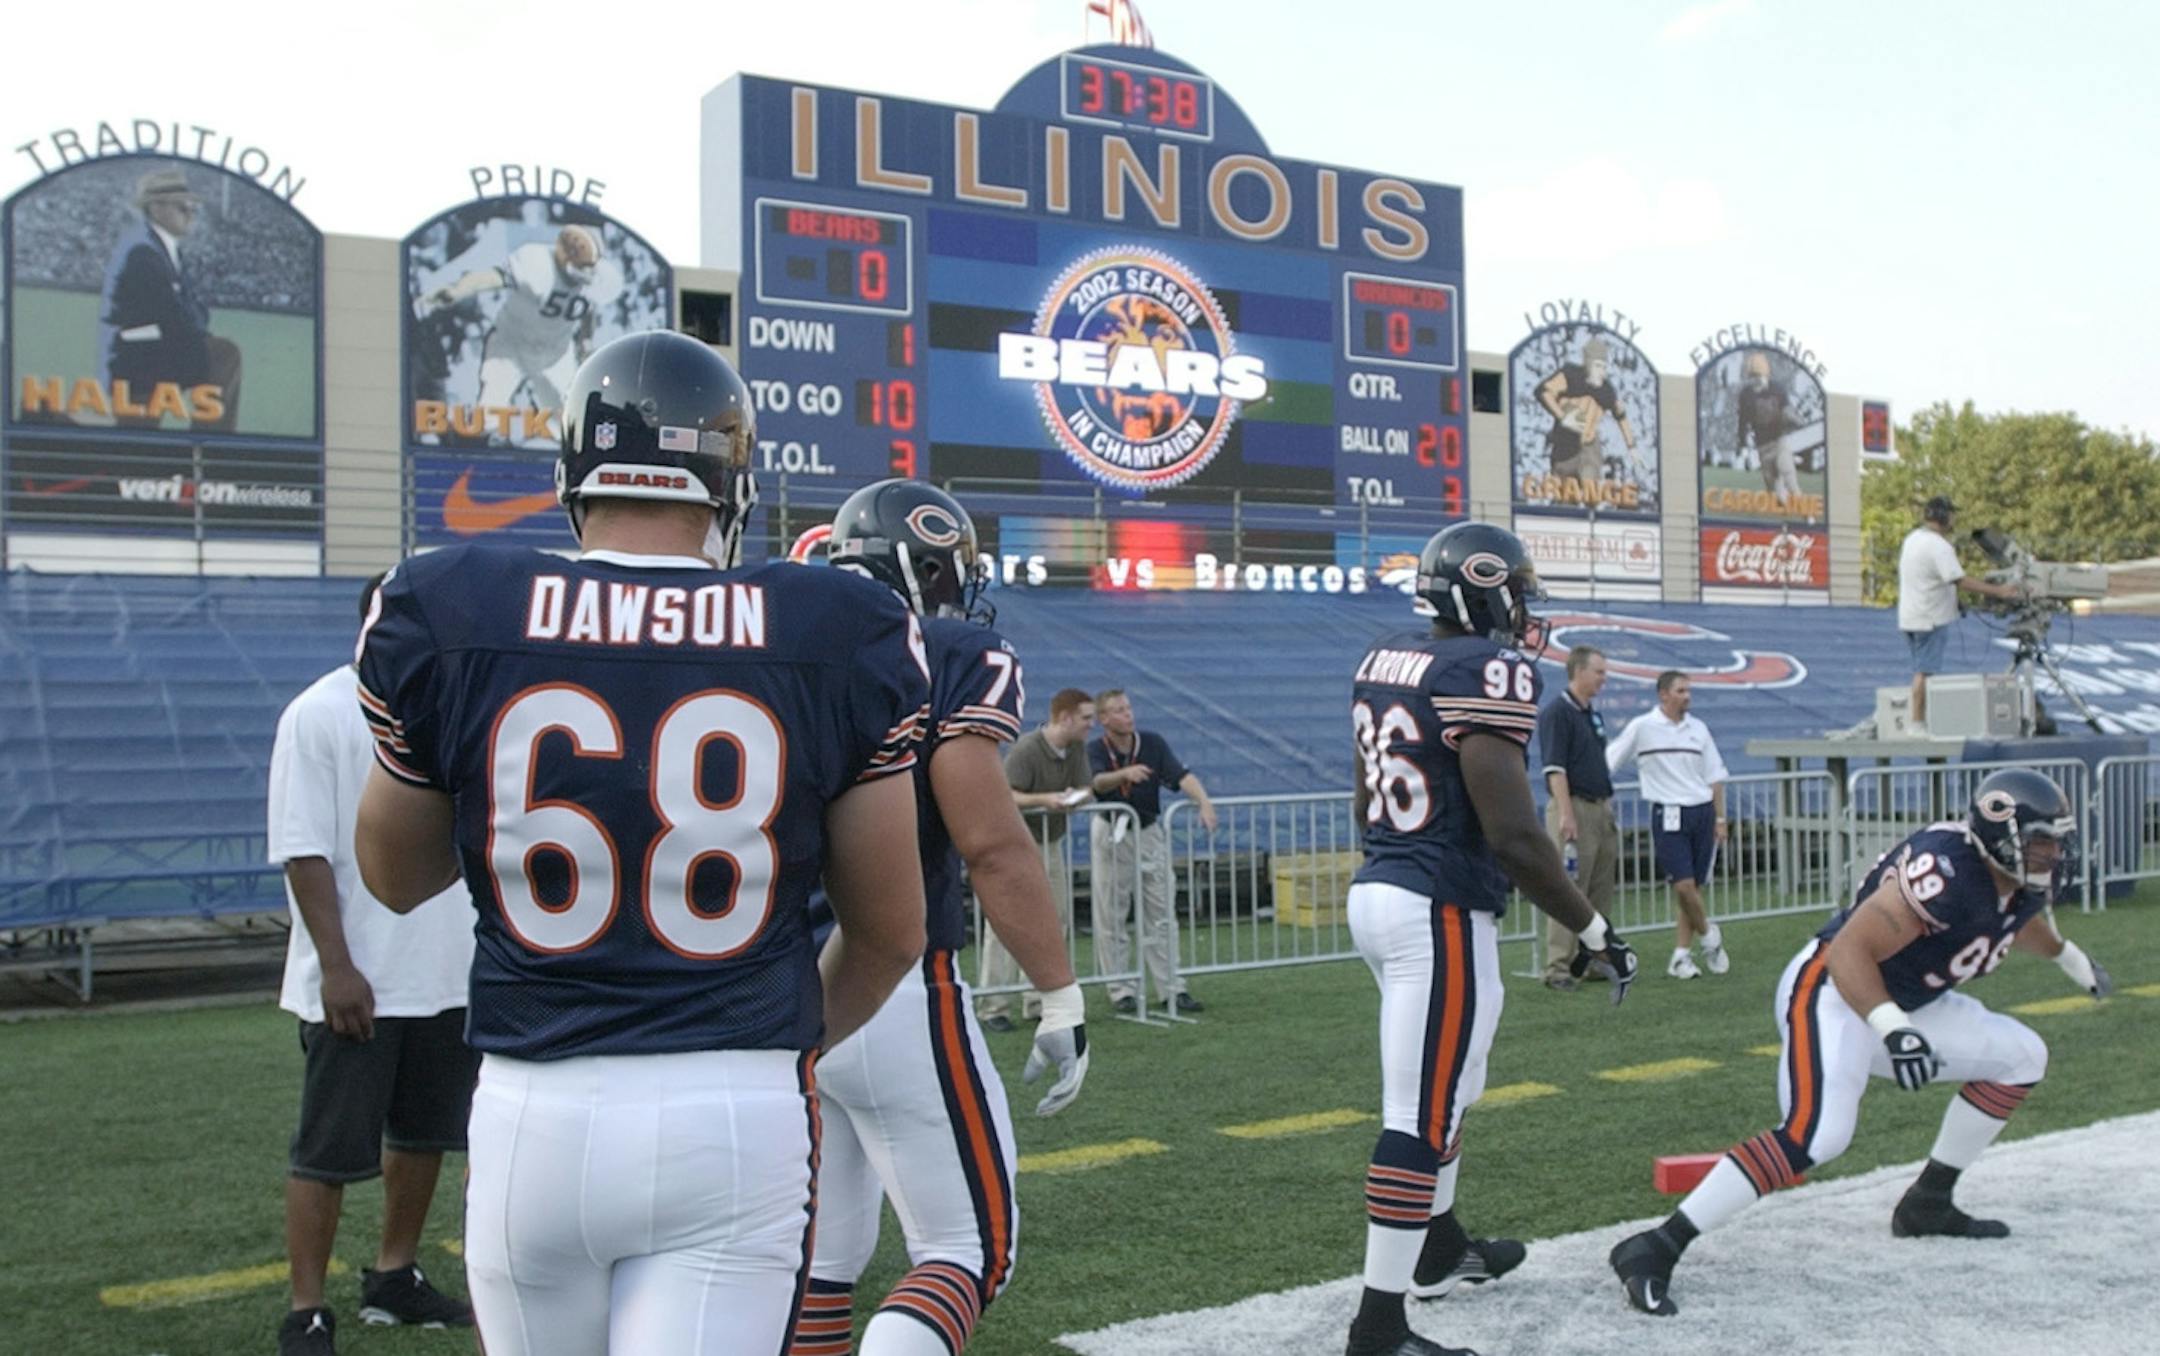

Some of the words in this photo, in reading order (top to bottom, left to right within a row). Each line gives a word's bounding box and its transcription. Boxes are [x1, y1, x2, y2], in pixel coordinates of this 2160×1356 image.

[1081, 64, 1198, 129] 37:38
[15, 118, 307, 202] TRADITION
[791, 86, 1430, 262] ILLINOIS
[469, 163, 607, 210] PRIDE
[787, 207, 881, 245] BEARS
[859, 250, 889, 302] 0
[1068, 269, 1122, 315] 2002
[1125, 268, 1202, 326] SEASON
[539, 291, 590, 322] 50
[1523, 297, 1642, 341] LOYALTY
[749, 316, 836, 354] DOWN
[902, 323, 916, 368] 1
[1386, 310, 1412, 356] 0
[1689, 322, 1829, 380] EXCELLENCE
[999, 332, 1269, 401] BEARS
[1348, 371, 1403, 402] QTR.
[21, 375, 226, 422] HALAS
[414, 399, 554, 439] BUTK
[750, 379, 791, 413] TO
[796, 382, 843, 417] GO
[871, 379, 917, 432] 10
[757, 439, 837, 475] T.O.L.
[1066, 408, 1094, 438] IN
[1090, 417, 1206, 469] CHAMPAIGN
[1340, 424, 1384, 455] BALL
[1384, 428, 1410, 455] ON
[1416, 422, 1463, 469] 20
[598, 472, 690, 490] BEARS
[1347, 476, 1406, 507] T.O.L.
[1442, 474, 1464, 518] 3
[1522, 473, 1640, 511] GRANGE
[1105, 556, 1156, 589] vs
[1193, 552, 1368, 594] Broncos
[526, 574, 766, 648] DAWSON
[1483, 658, 1534, 702] 96
[486, 681, 788, 961] 68
[1906, 851, 1946, 902] 99
